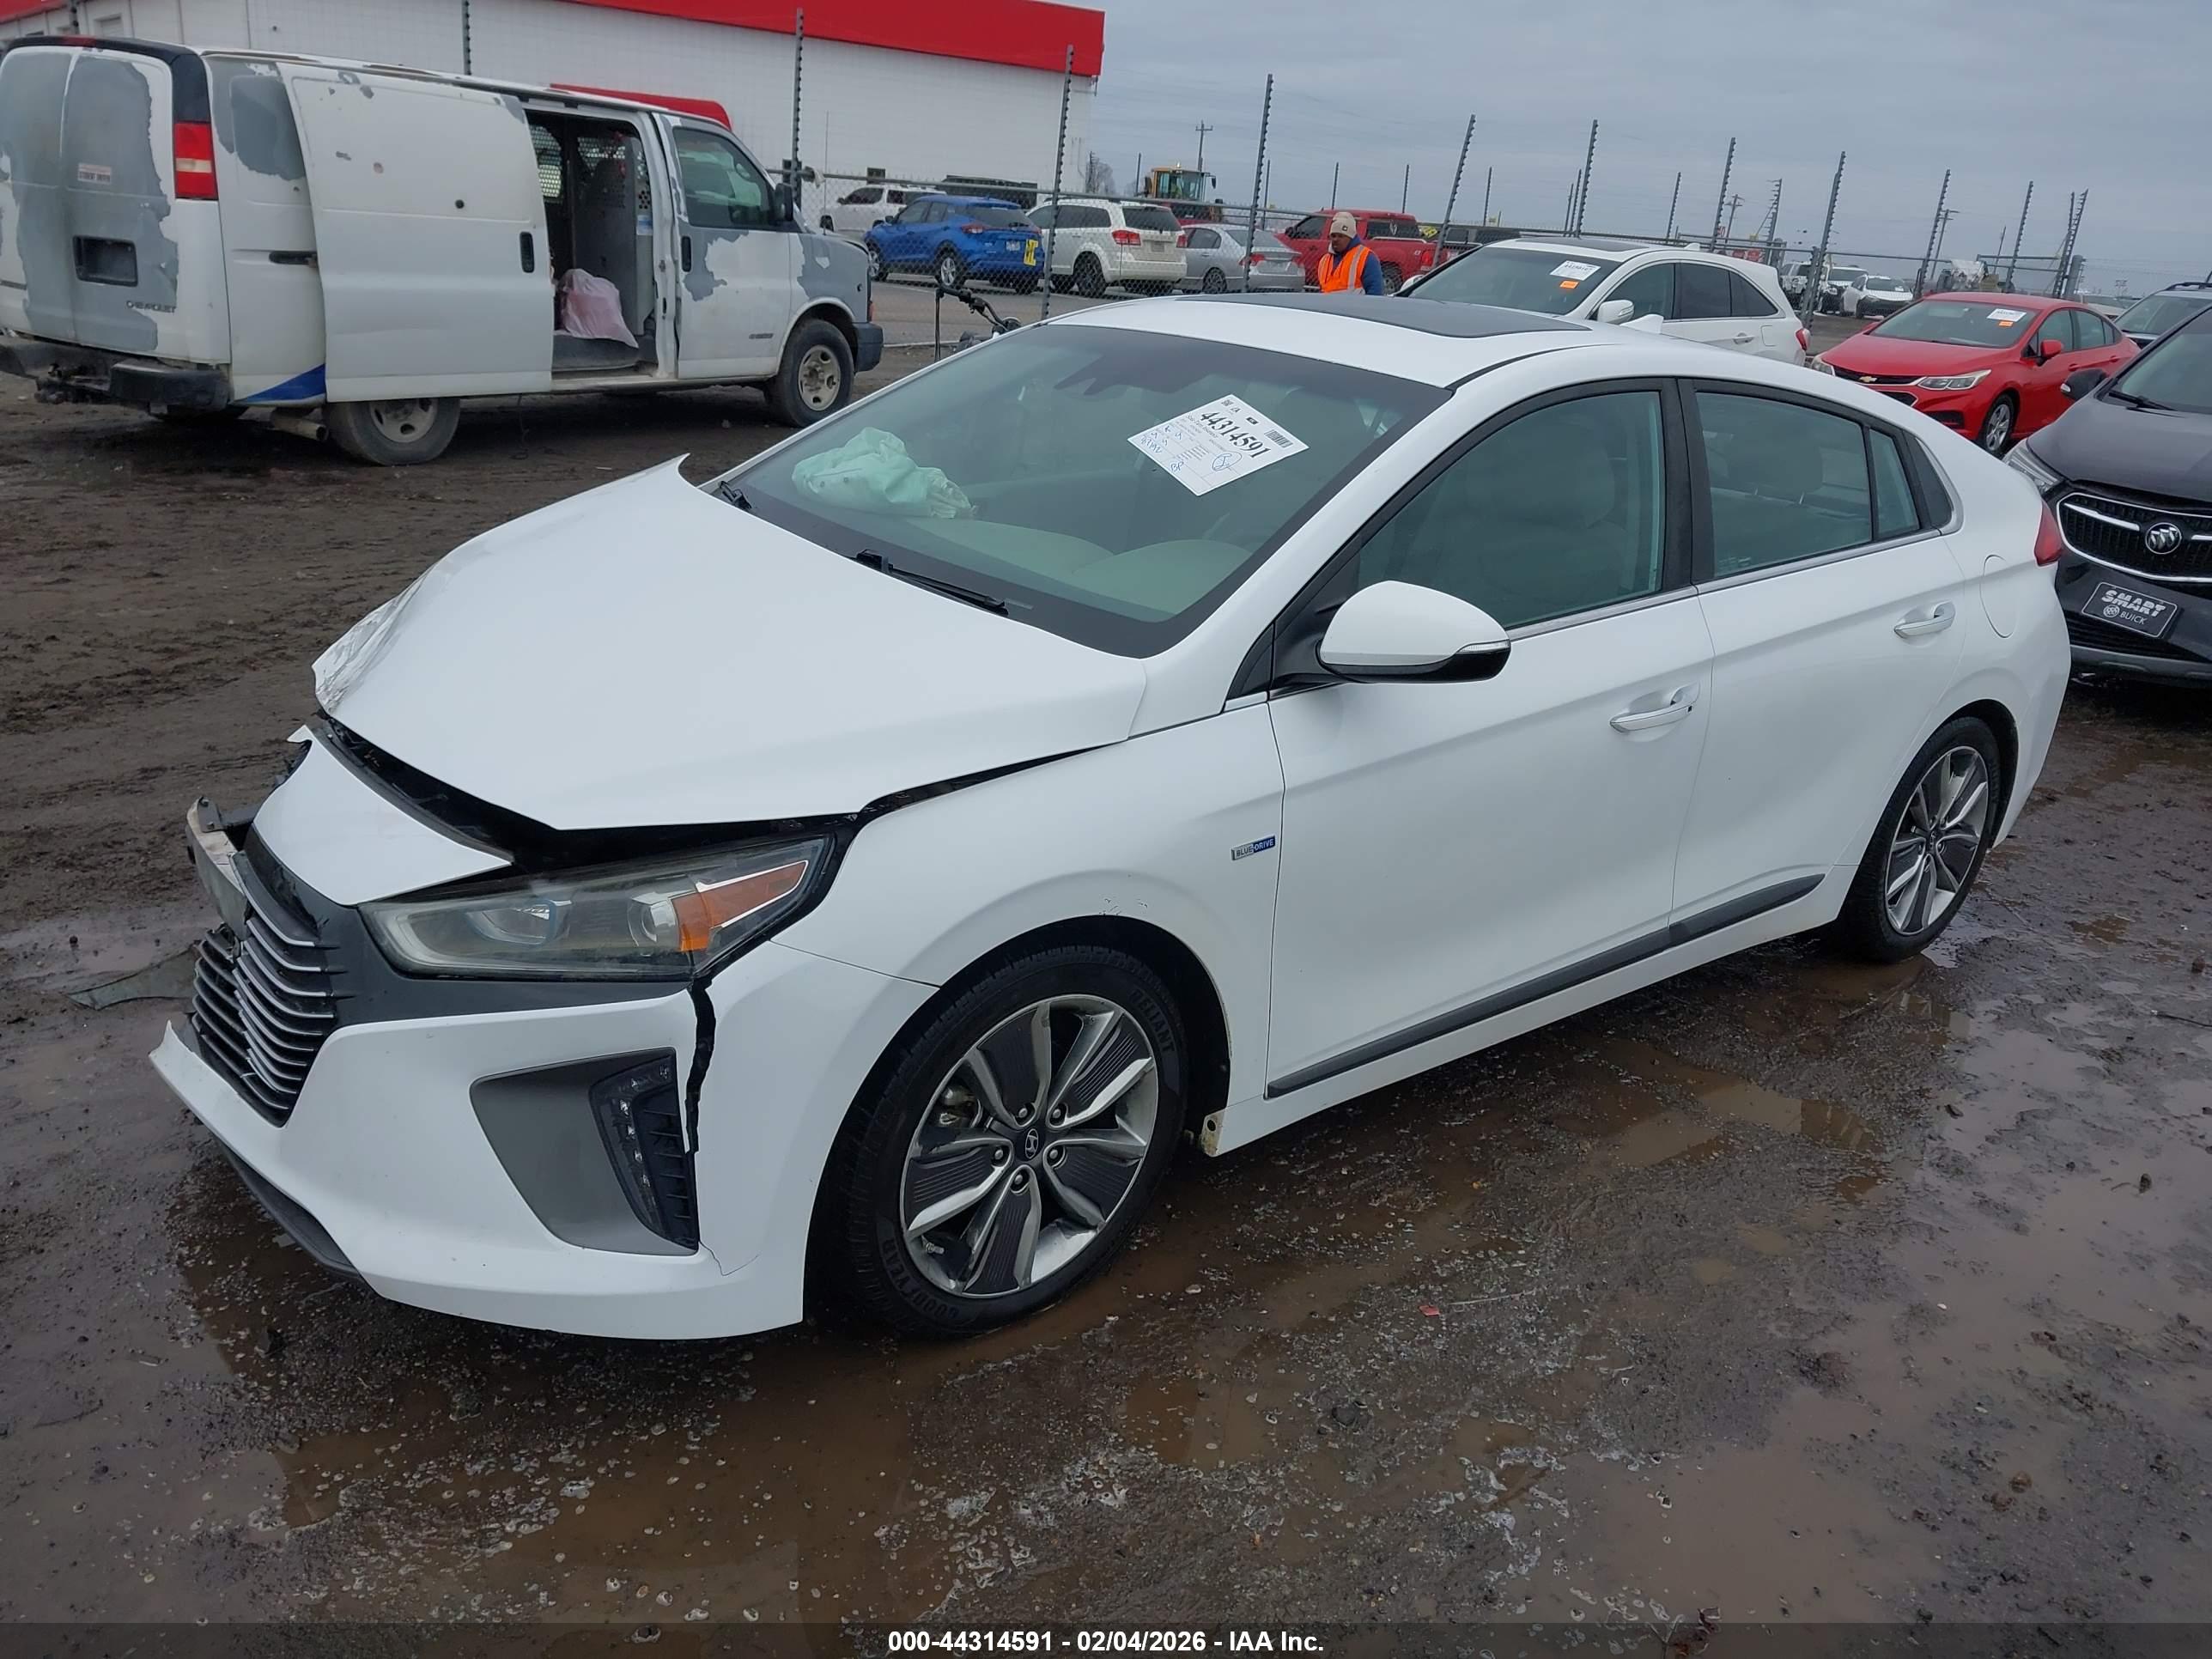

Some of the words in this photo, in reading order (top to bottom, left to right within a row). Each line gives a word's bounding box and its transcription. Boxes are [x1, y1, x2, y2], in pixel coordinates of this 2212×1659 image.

[1199, 411, 1273, 459] 44314591
[2101, 590, 2166, 617] SMART
[2119, 611, 2148, 625] BUICK
[1129, 989, 1176, 1052] RELIANT
[883, 1239, 960, 1320] GOODYEAR
